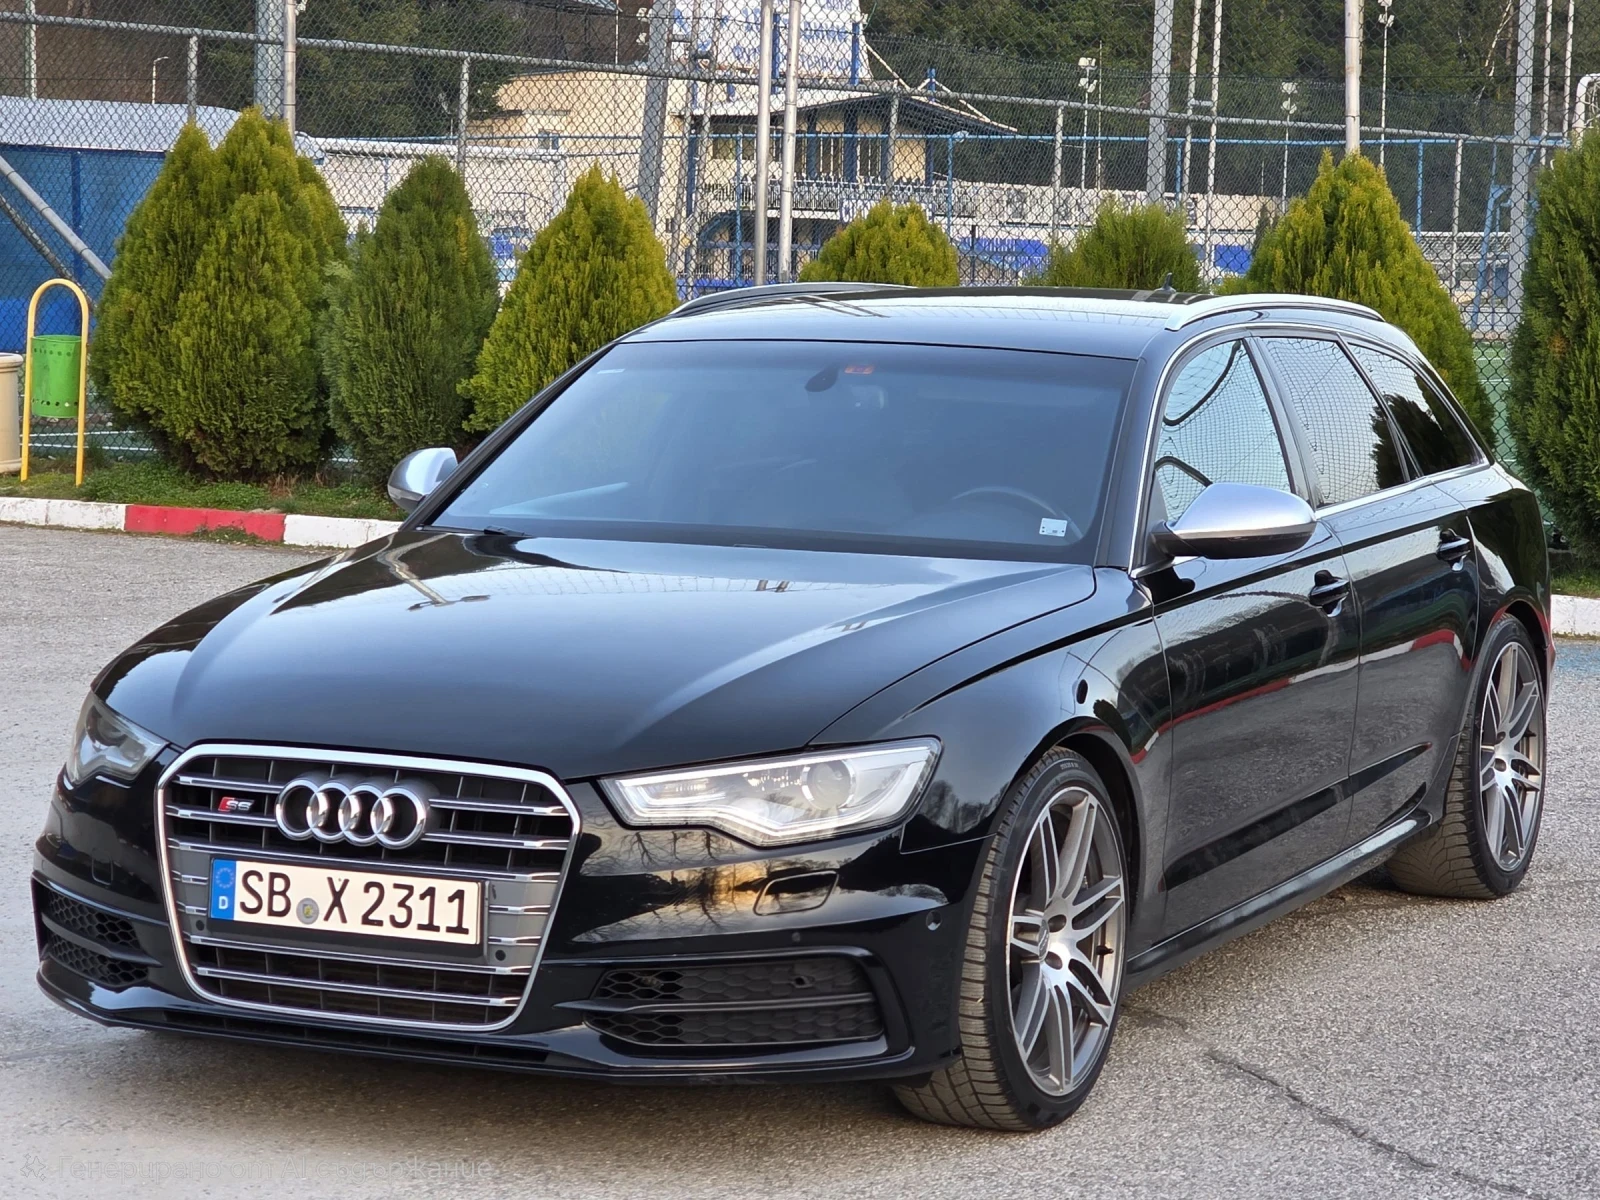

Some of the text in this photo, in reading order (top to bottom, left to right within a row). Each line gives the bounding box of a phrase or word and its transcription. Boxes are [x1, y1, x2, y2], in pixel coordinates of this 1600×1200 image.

[218, 896, 229, 910] D
[239, 869, 470, 935] SB X 2311
